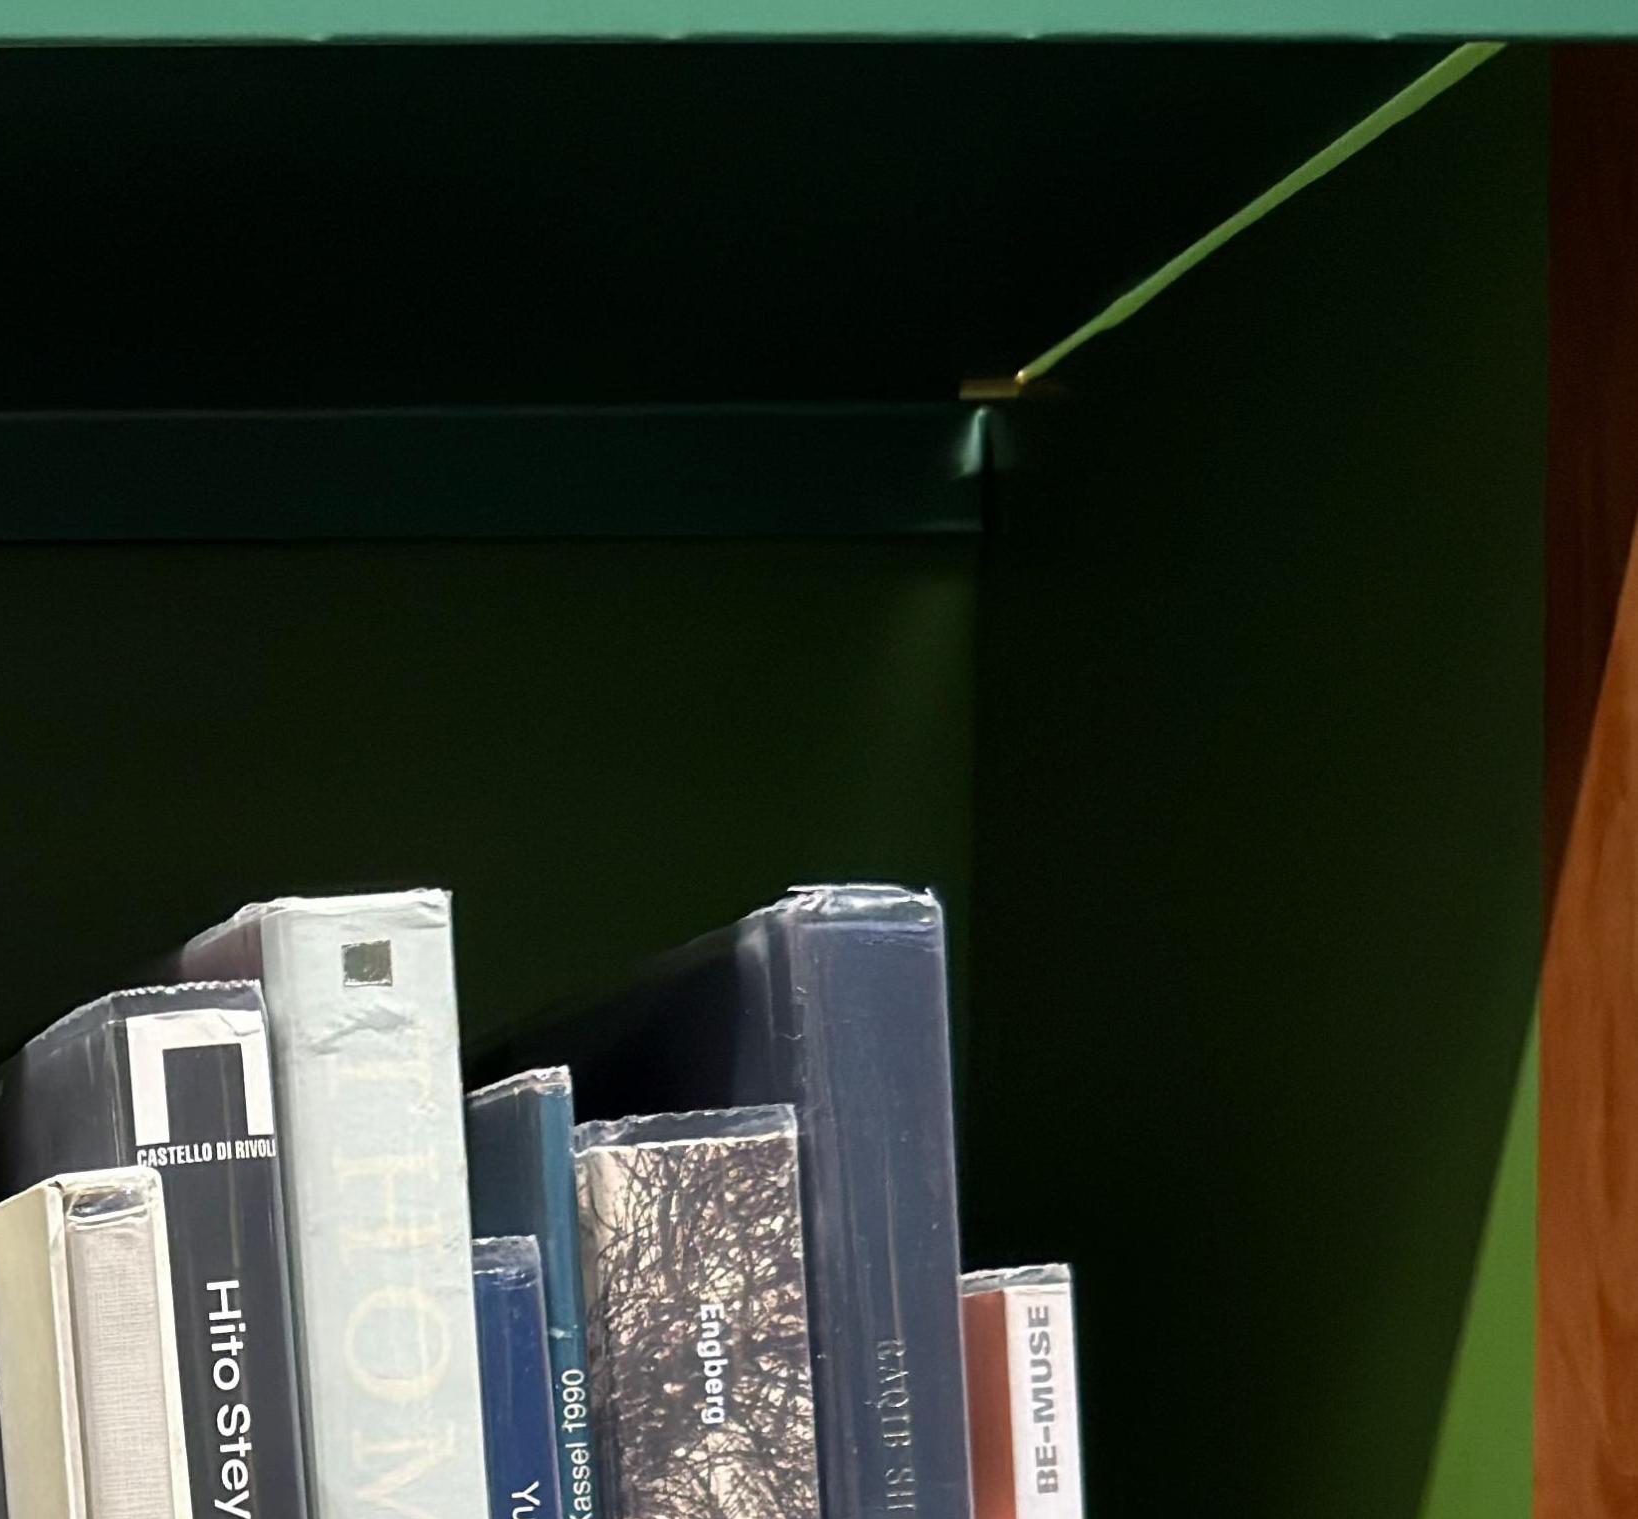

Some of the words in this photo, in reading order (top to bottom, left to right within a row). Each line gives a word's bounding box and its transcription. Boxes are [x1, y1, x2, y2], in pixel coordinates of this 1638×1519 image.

[207, 1280, 245, 1390] Hito
[699, 1302, 726, 1425] Engberg
[562, 1369, 586, 1432] 1990
[1028, 1306, 1058, 1493] BE-MUSE
